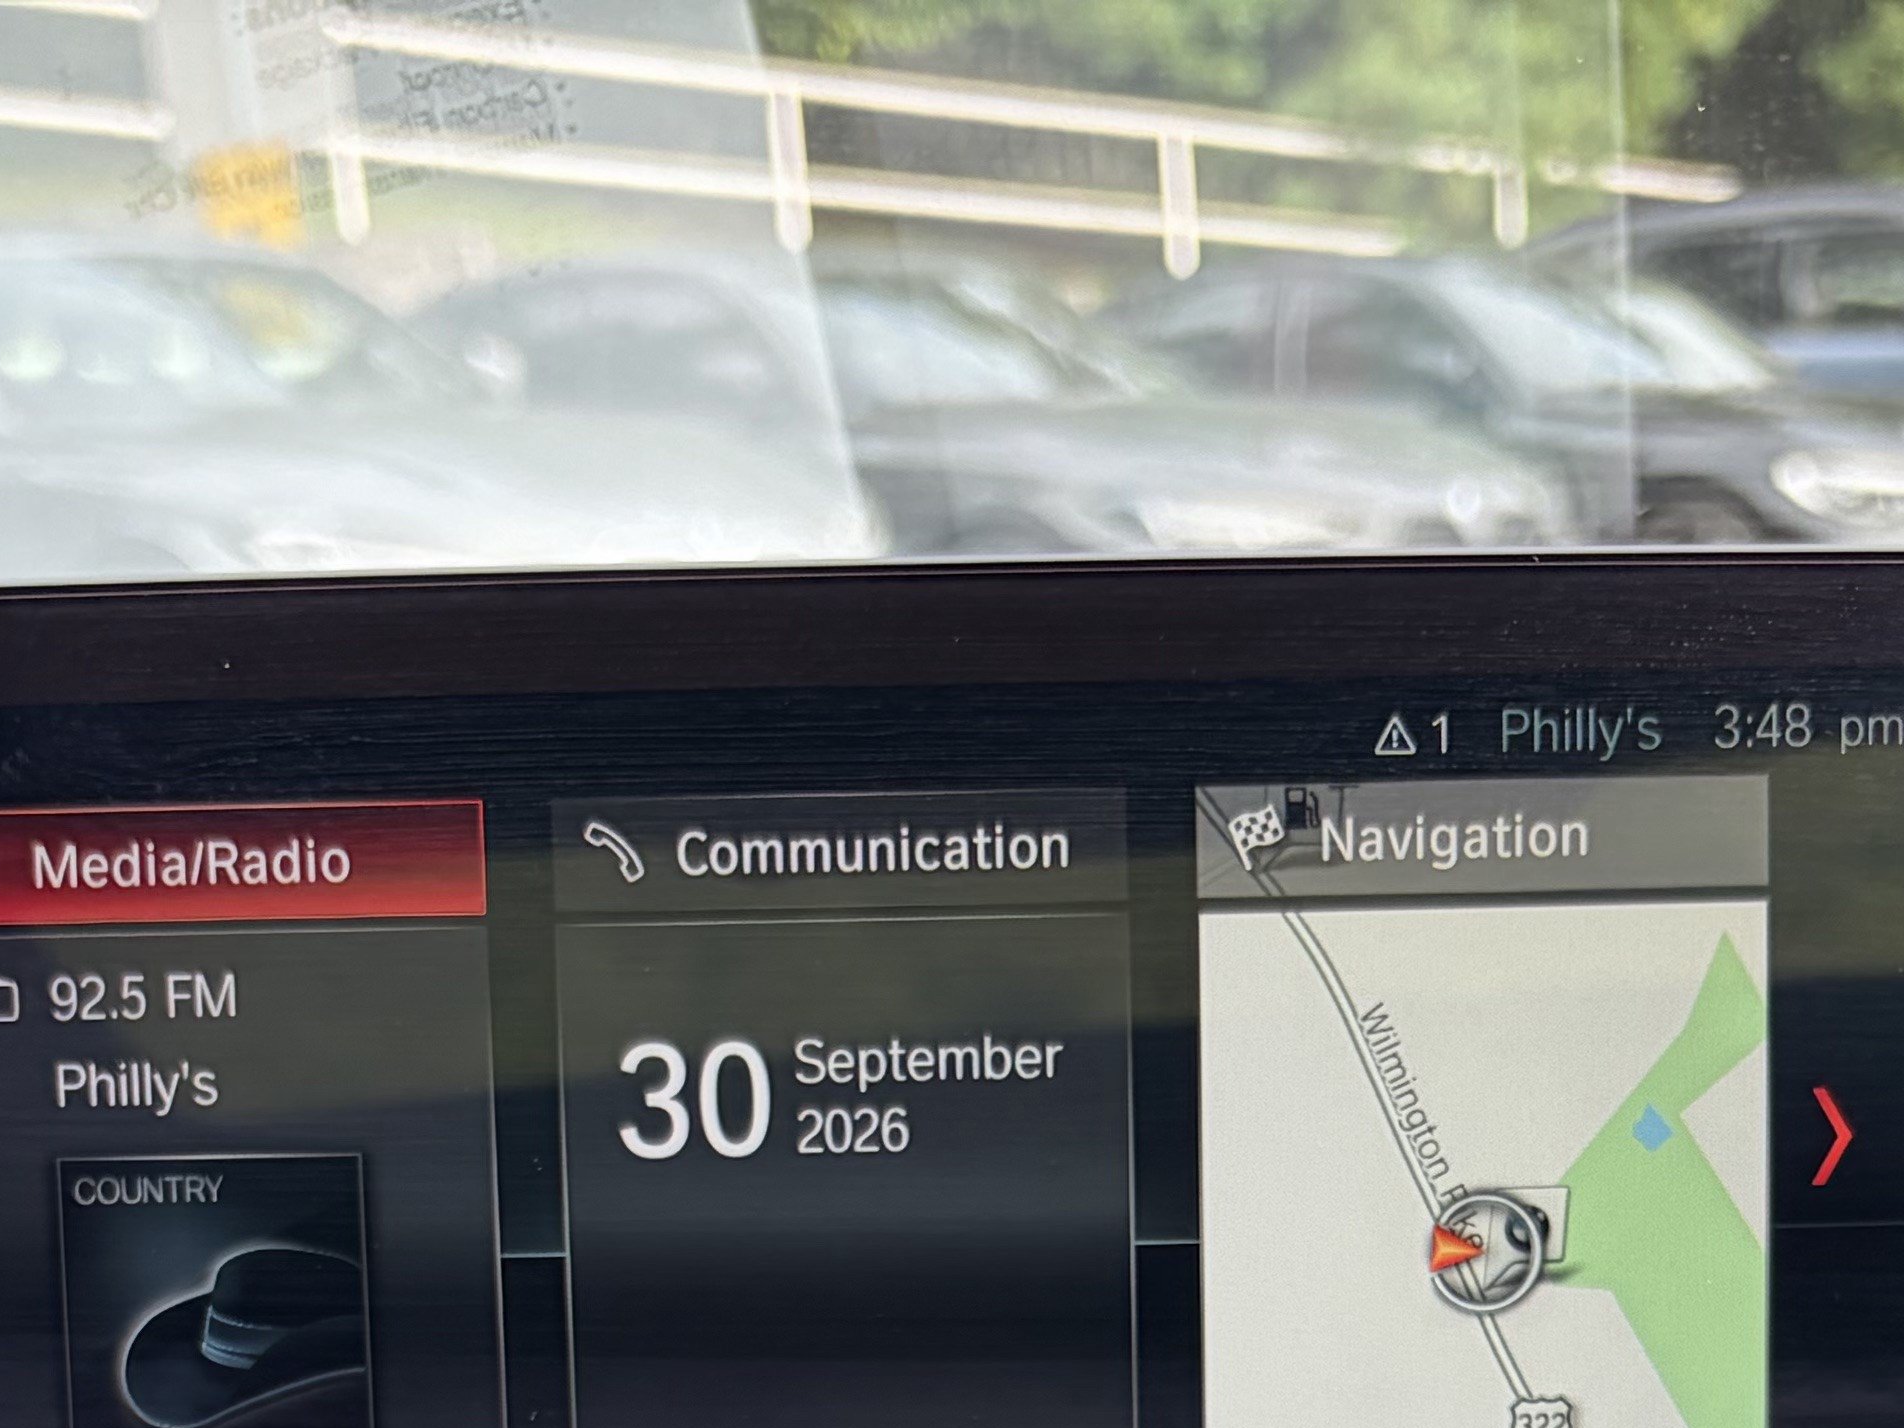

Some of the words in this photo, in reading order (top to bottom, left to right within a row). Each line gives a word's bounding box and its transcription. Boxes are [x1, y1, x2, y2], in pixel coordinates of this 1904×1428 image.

[1432, 715, 1449, 753] 1
[1500, 708, 1662, 761] Philly's
[1714, 703, 1811, 748] 3:48
[1840, 711, 1903, 755] pm
[32, 839, 350, 889] Media/Radio
[677, 825, 1068, 877] Communication
[1320, 814, 1588, 869] Navigation
[48, 973, 147, 1022] 92.5
[166, 972, 237, 1018] FM
[55, 1062, 219, 1116] Philly's
[795, 1036, 1063, 1092] September
[1360, 1001, 1450, 1181] Wilmington
[619, 1038, 772, 1161] 30
[797, 1107, 909, 1155] 2026
[73, 1174, 223, 1206] COUNTRY
